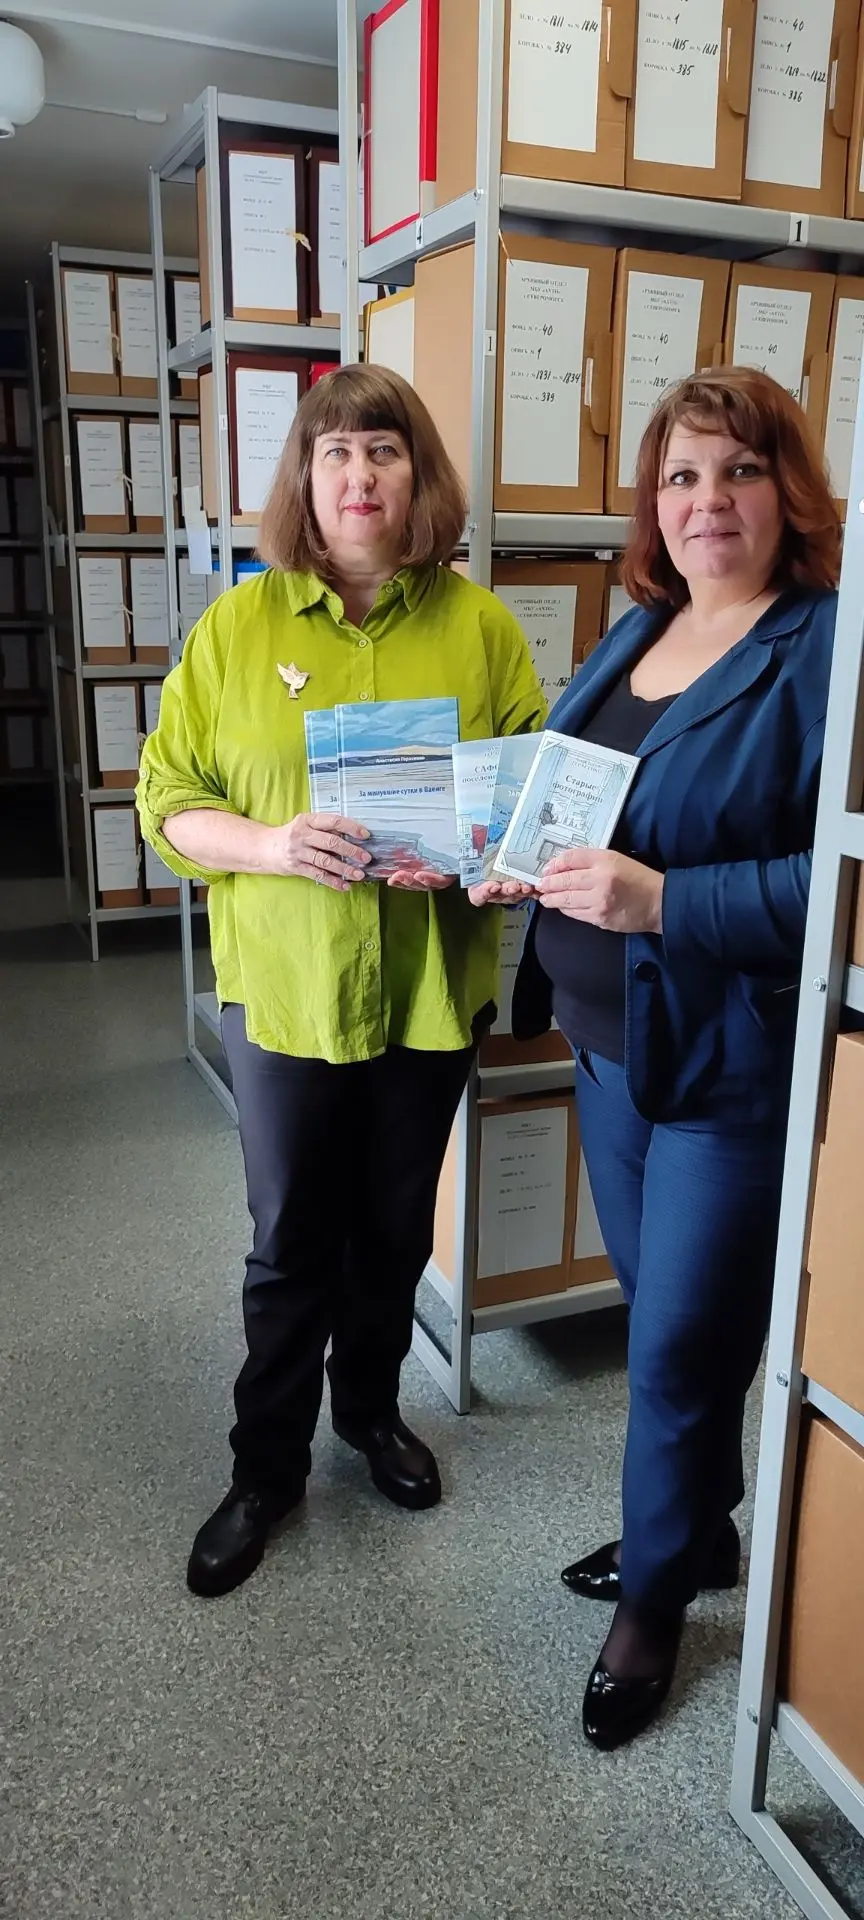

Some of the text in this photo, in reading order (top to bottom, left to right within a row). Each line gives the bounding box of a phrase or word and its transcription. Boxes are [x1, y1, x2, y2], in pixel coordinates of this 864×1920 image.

[549, 15, 564, 28] 1811
[581, 20, 599, 32] 1814
[674, 13, 680, 24] 1
[792, 18, 804, 31] 40
[554, 40, 572, 54] 384
[672, 37, 689, 51] 1815
[702, 43, 718, 55] 1818
[786, 41, 792, 53] 1
[676, 64, 695, 76] 385
[785, 65, 799, 76] 1819
[810, 70, 826, 83] 1822
[788, 89, 803, 103] 386
[416, 223, 422, 244] 4
[796, 220, 802, 241] 1
[542, 323, 553, 336] 40
[488, 336, 493, 351] 1
[659, 332, 668, 344] 40
[537, 347, 542, 360] 1
[768, 343, 778, 354] 40
[654, 355, 659, 366] 1
[536, 370, 552, 381] 1831
[563, 372, 581, 384] 1834
[653, 377, 669, 388] 1835
[541, 391, 555, 403] 389
[536, 638, 547, 647] 40
[565, 774, 597, 791] Старые
[367, 788, 400, 797] минувшие
[400, 788, 418, 796] сутки
[423, 785, 446, 793] Ваенге
[552, 782, 603, 804] фотографии
[329, 795, 338, 803] За
